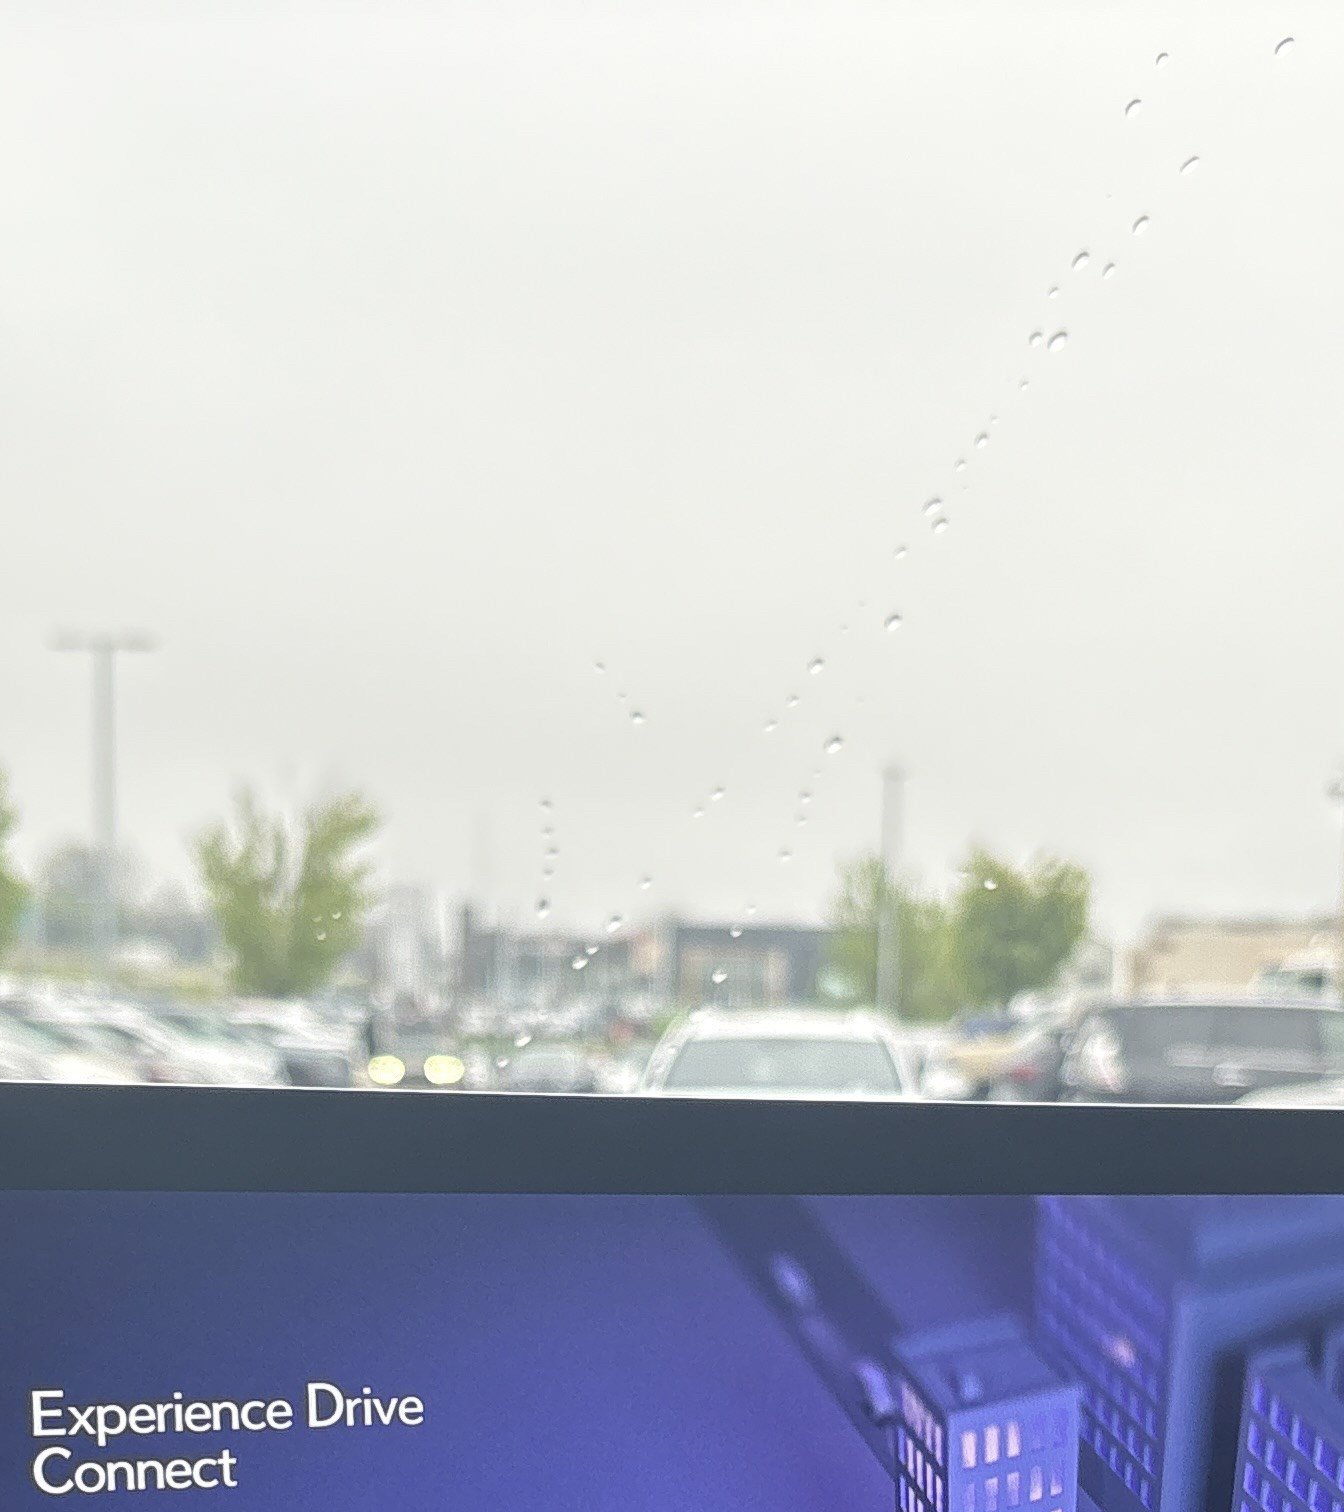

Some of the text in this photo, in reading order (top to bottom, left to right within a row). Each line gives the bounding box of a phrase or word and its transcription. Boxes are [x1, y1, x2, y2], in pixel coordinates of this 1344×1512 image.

[32, 1382, 424, 1446] Experience Drive
[33, 1446, 237, 1494] Connect
